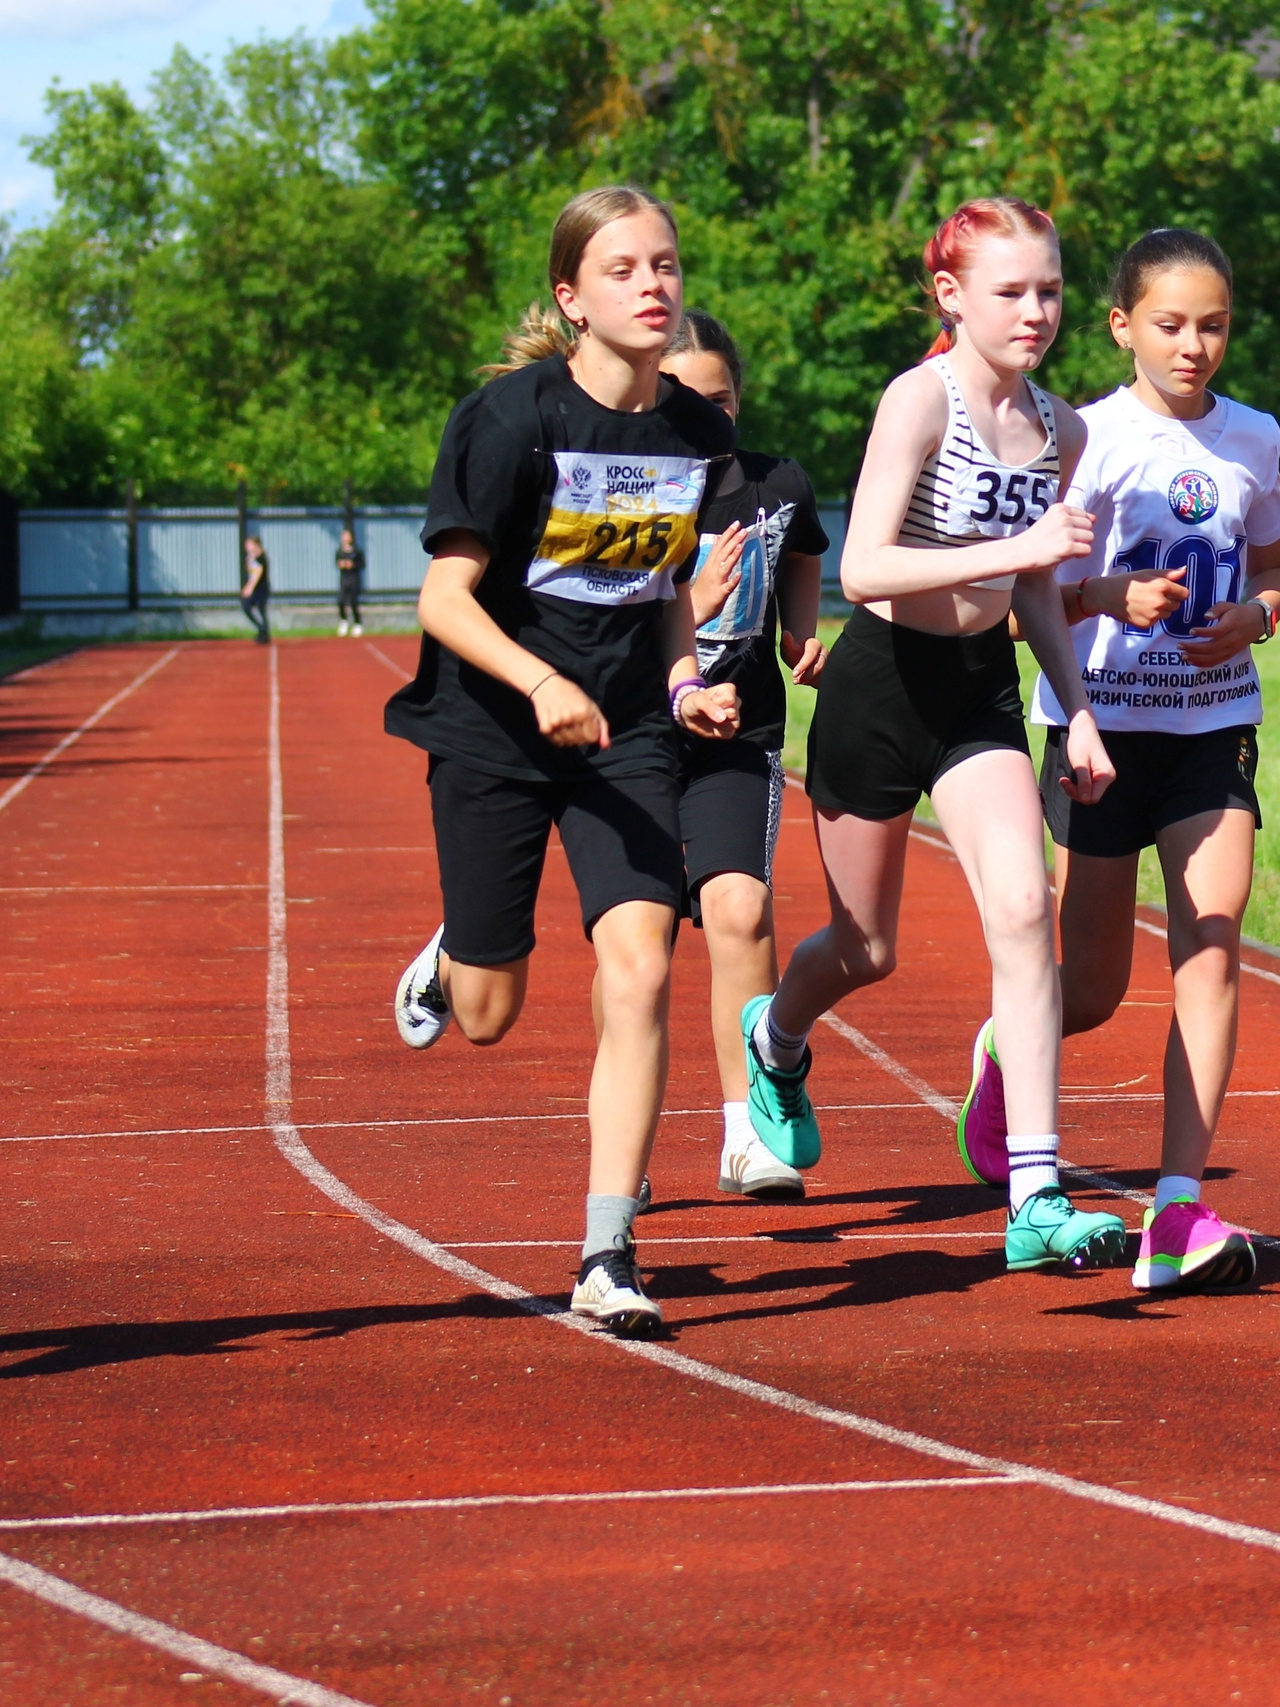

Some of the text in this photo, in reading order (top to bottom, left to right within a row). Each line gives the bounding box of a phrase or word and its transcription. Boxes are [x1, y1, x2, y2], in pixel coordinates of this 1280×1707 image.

[606, 465, 645, 479] КРОСС
[970, 471, 1049, 527] 355
[585, 522, 672, 567] 215
[582, 565, 649, 585] ПСКОВСКАЯ
[1113, 534, 1246, 639] 101
[587, 580, 639, 596] ОБЛАСТЬ
[1138, 651, 1191, 666] СЕБЕЖ
[1081, 664, 1231, 688] ДЕТСКО-ЮНОШЕСКИЙ
[1187, 680, 1260, 709] ПОДГОТОВКИ
